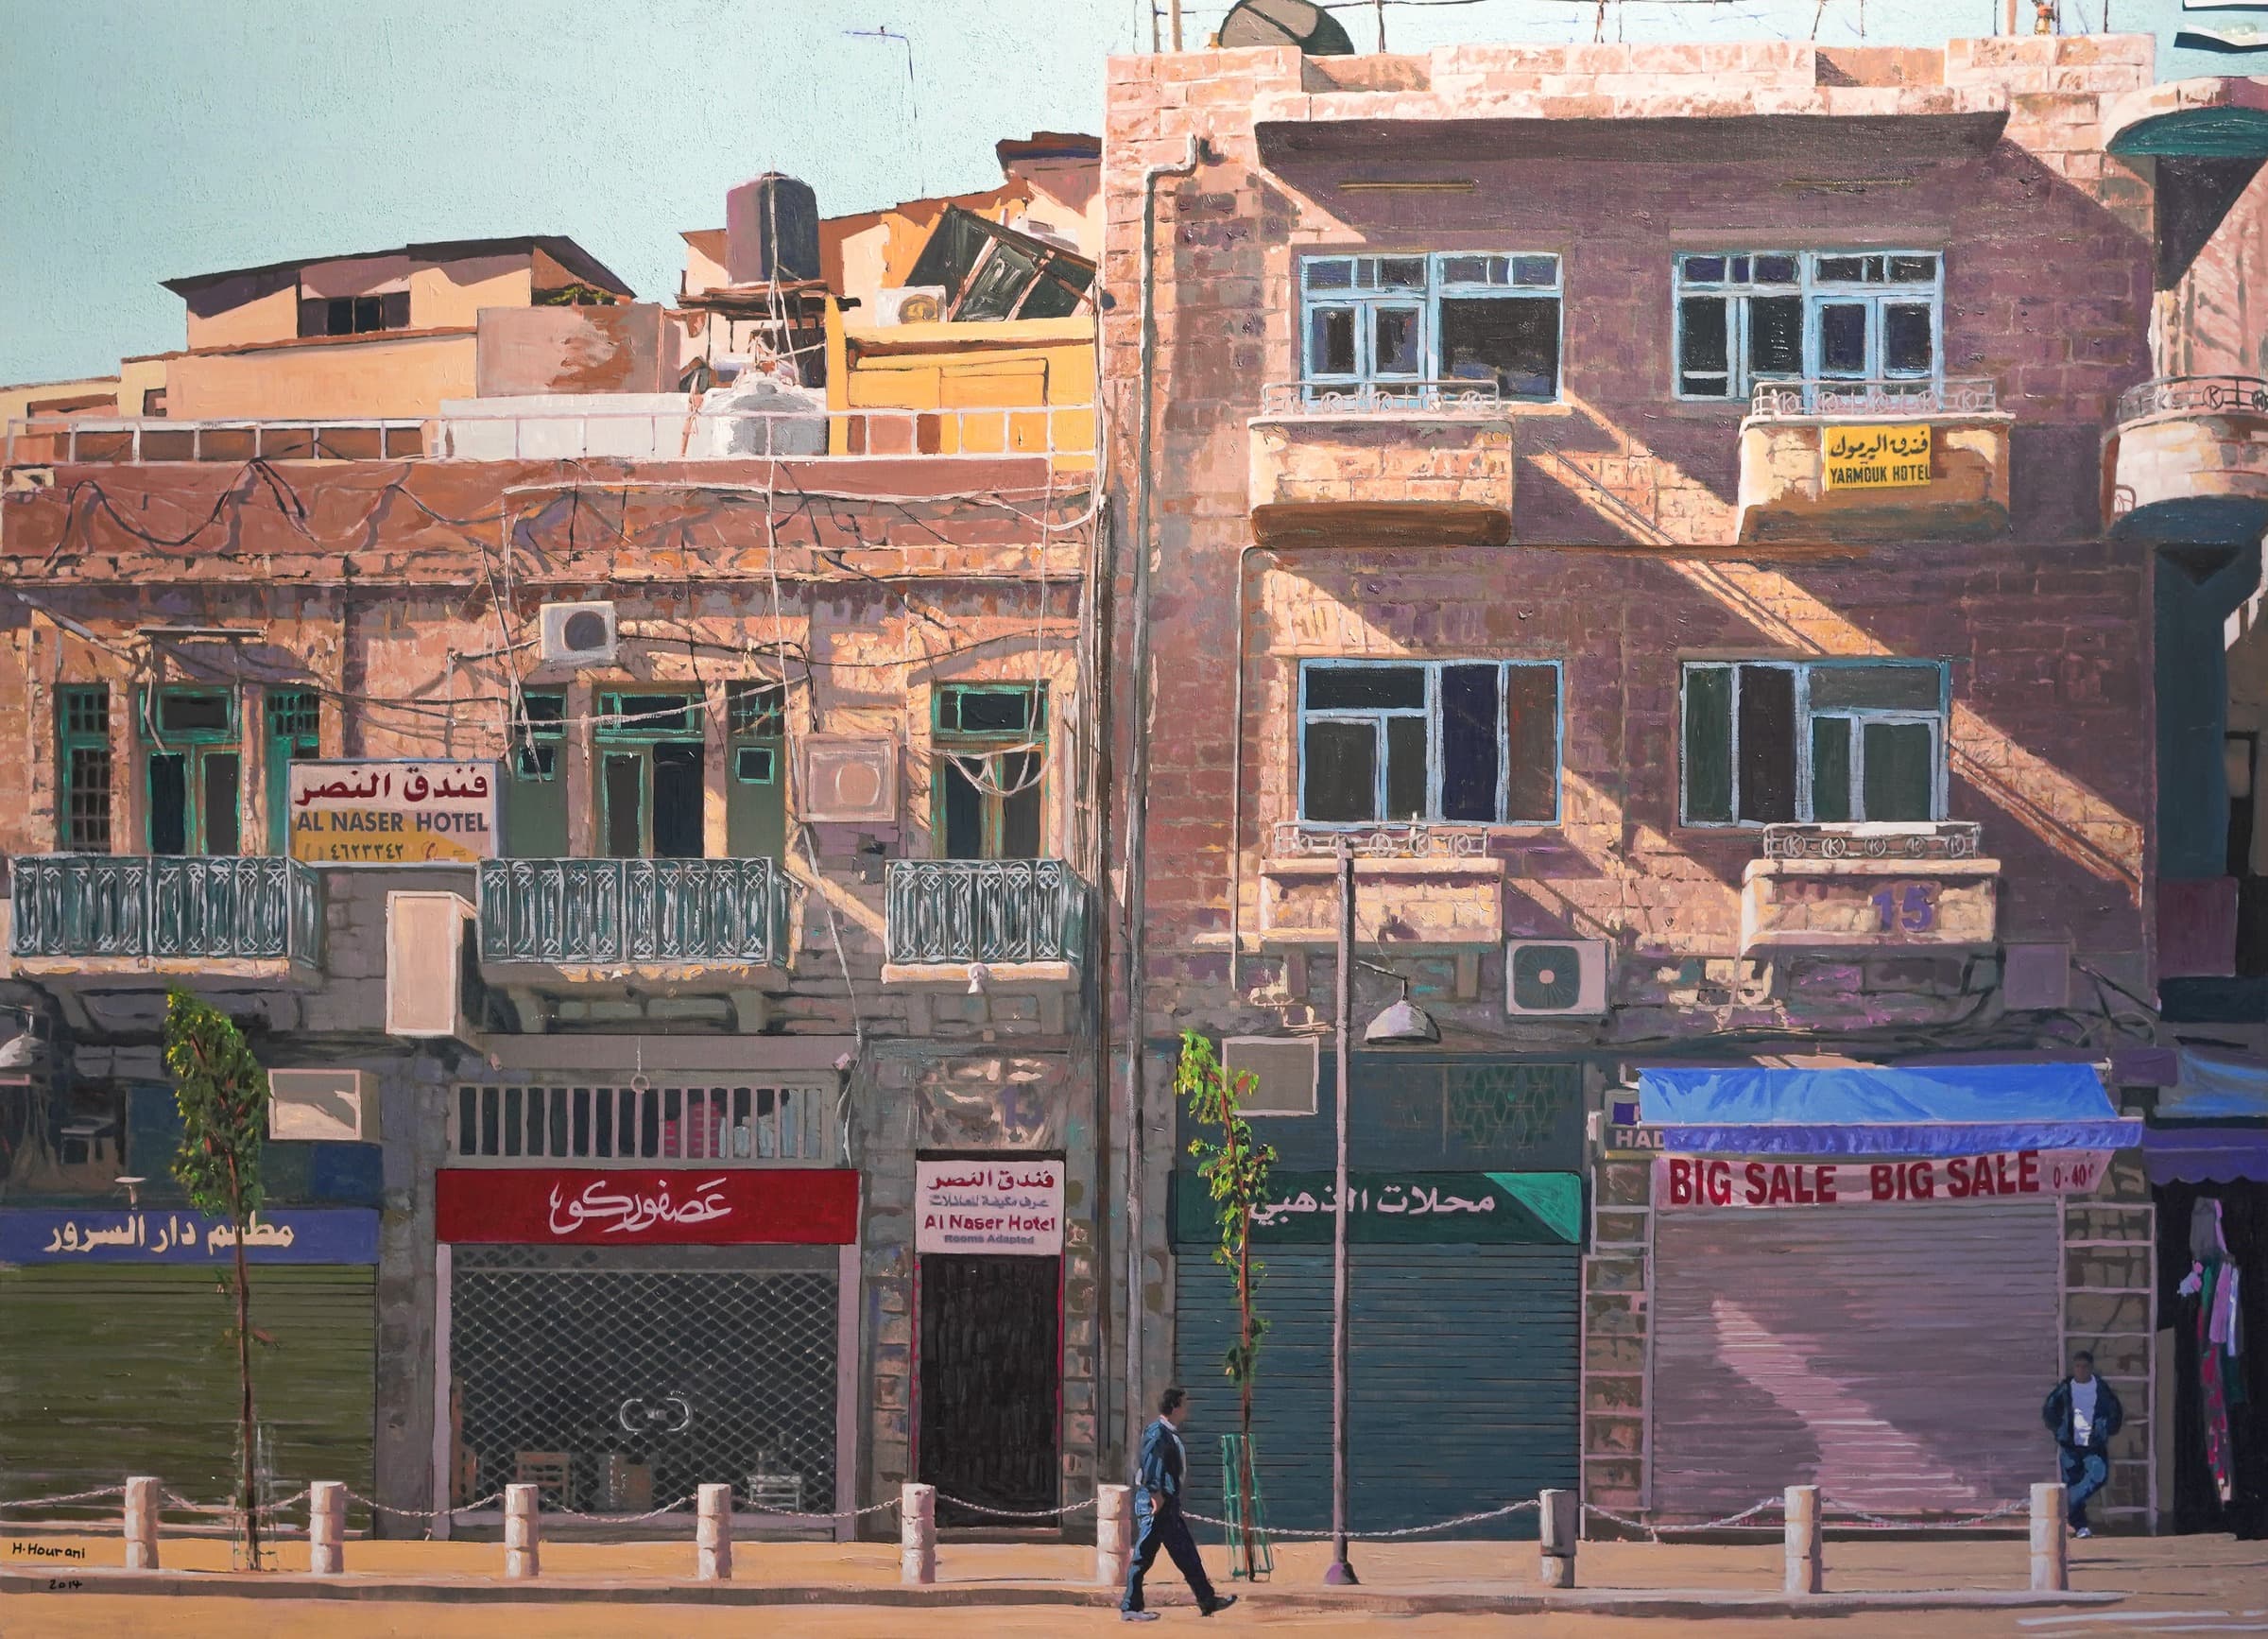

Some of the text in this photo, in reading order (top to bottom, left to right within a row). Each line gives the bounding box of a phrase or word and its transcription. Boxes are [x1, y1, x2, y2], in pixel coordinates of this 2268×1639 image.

[1890, 430, 1929, 457] فندق
[1830, 464, 1931, 484] YARMOUK HOTEL
[295, 766, 488, 805] فندق النصر
[297, 813, 489, 832] AL NASER HOTEL
[1872, 885, 1933, 932] 15
[926, 1168, 1055, 1190] فندق النصر
[1670, 1159, 1731, 1205] BIG
[1745, 1163, 1836, 1204] SALE
[1870, 1162, 1933, 1200] BIG
[1947, 1149, 2039, 1198] SALE
[1377, 1185, 1495, 1215] محلات
[43, 1214, 146, 1252] السرور
[151, 1216, 197, 1253] دار
[925, 1215, 1056, 1232] Al Naser Hotel
[944, 1234, 985, 1244] Rooms
[49, 1579, 82, 1590] 2014
